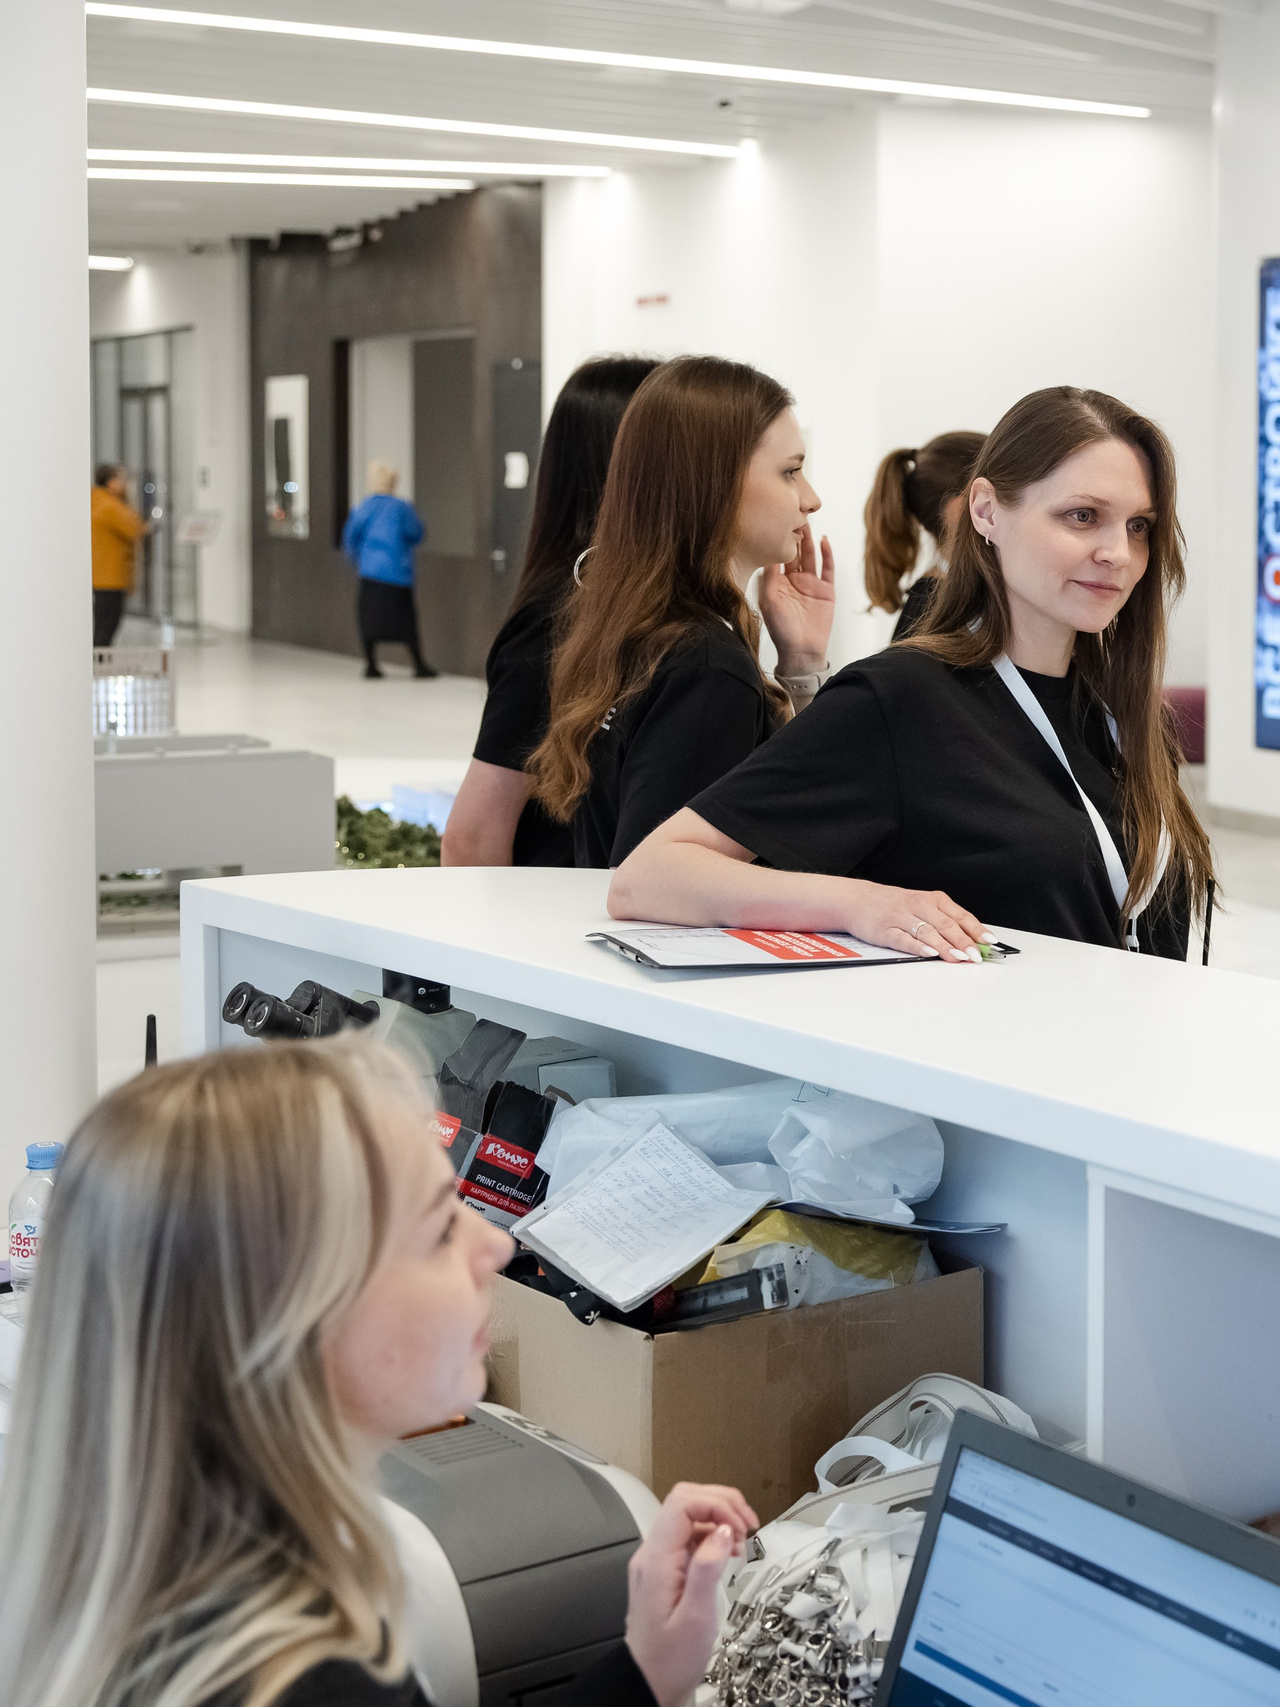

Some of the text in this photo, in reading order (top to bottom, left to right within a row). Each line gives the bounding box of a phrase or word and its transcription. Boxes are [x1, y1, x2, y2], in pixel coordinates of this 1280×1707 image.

[470, 1187, 498, 1203] КАРТРИДЖ
[497, 1198, 510, 1208] ДЛЯ
[475, 1174, 532, 1203] PRINT CARTRIDGE
